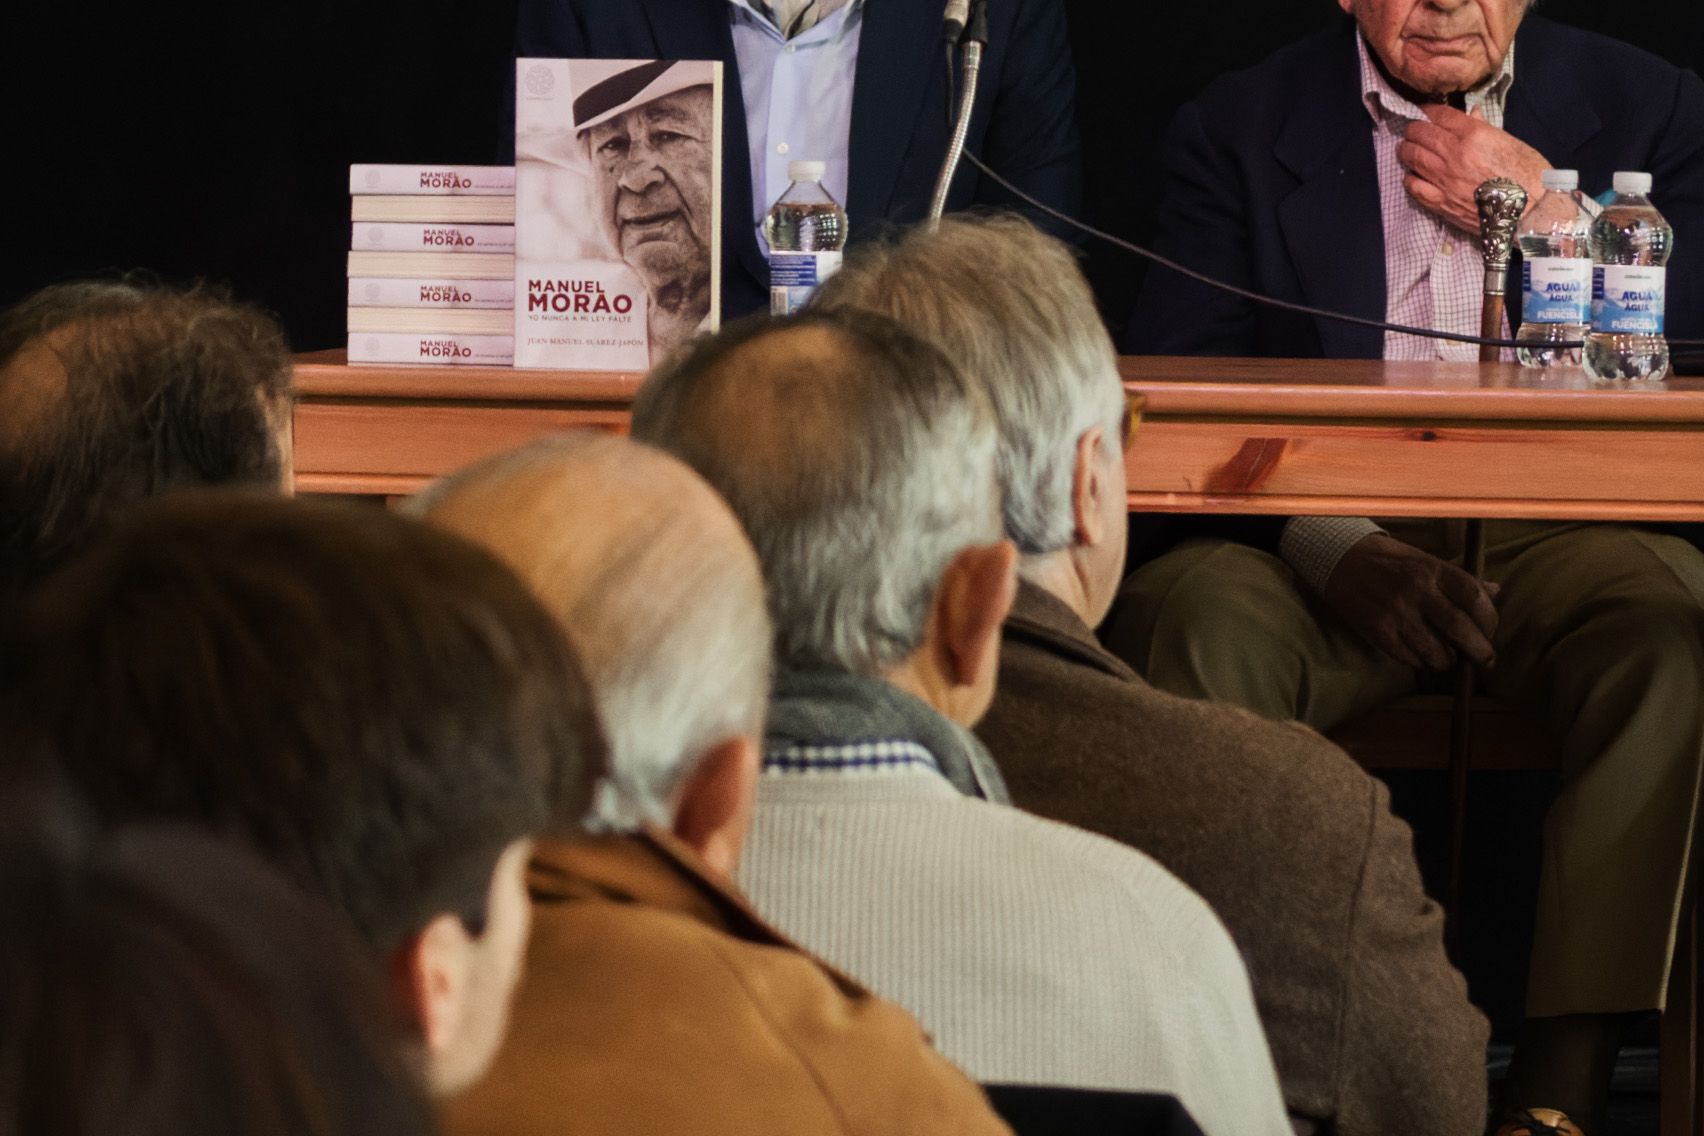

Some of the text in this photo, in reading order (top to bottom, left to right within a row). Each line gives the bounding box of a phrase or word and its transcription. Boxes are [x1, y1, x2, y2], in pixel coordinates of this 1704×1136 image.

[421, 178, 472, 188] MORAO
[424, 235, 475, 246] MORAO
[528, 279, 605, 293] MANUEL
[421, 292, 472, 302] MORAO
[528, 293, 633, 314] MORAO
[527, 337, 547, 345] JUAN
[421, 346, 472, 357] MORAO
